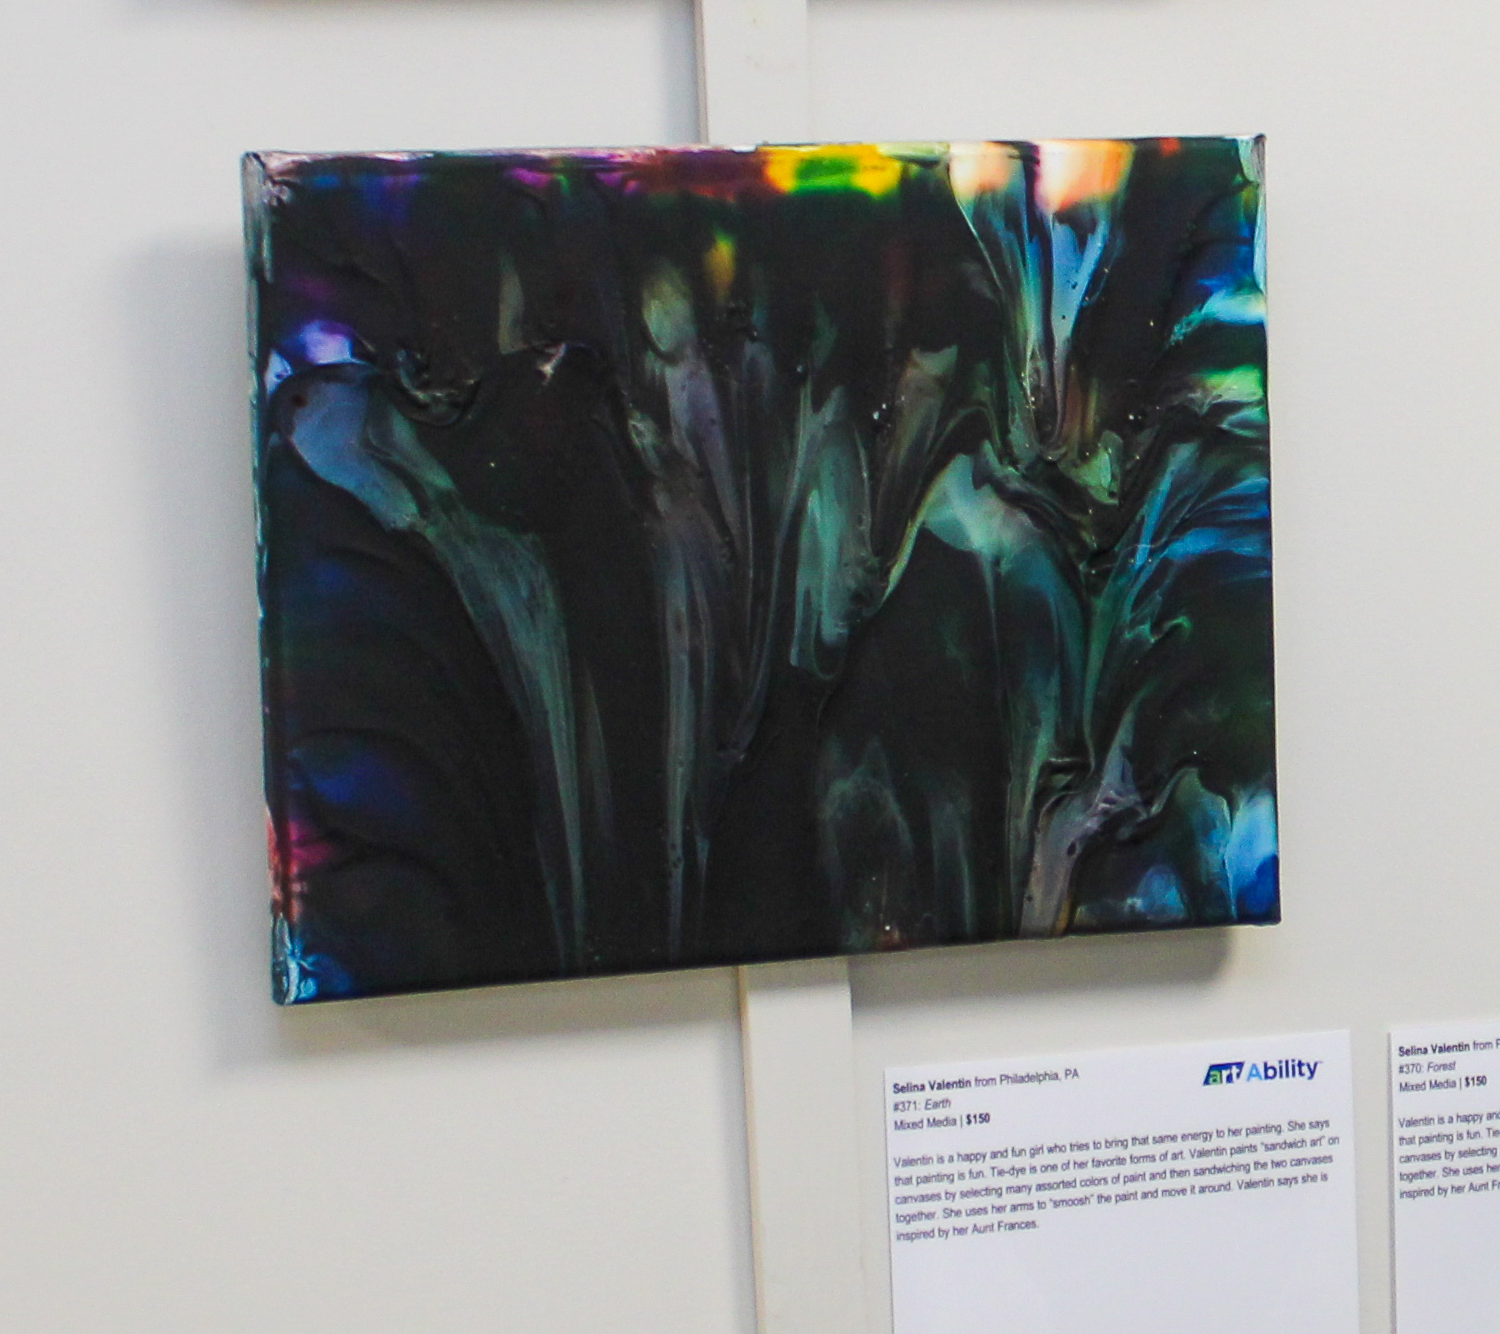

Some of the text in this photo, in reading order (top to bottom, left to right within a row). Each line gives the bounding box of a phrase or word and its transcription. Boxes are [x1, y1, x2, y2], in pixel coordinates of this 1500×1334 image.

[1398, 1045, 1428, 1056] Selina
[1430, 1042, 1470, 1053] Valentin
[1472, 1040, 1493, 1050] from
[1246, 1058, 1319, 1082] Ability
[1426, 1061, 1455, 1071] Forest
[892, 1082, 925, 1093] Selina
[928, 1078, 971, 1090] Valentin
[974, 1076, 996, 1086] from
[1064, 1068, 1079, 1078] PA
[1399, 1075, 1486, 1091] Mixed Media $150
[924, 1098, 951, 1110] Earth
[894, 1112, 990, 1130] Mixed Media $150
[1398, 1116, 1434, 1127] Valentin
[1437, 1115, 1445, 1124] is
[1447, 1115, 1453, 1123] a
[1455, 1113, 1483, 1123] happy
[893, 1155, 933, 1167] Valentin
[936, 1154, 944, 1164] is
[947, 1154, 954, 1163] a
[956, 1152, 986, 1163] happy
[989, 1147, 1008, 1159] and
[1010, 1146, 1026, 1157] fun
[1029, 1144, 1044, 1158] girl
[1046, 1143, 1066, 1153] who
[1069, 1141, 1089, 1152] tries
[1092, 1140, 1101, 1149] to
[1104, 1138, 1128, 1149] bring
[1131, 1135, 1149, 1146] that
[1152, 1134, 1178, 1144] same
[1180, 1131, 1213, 1142] energy
[1215, 1128, 1225, 1138] to
[1227, 1127, 1242, 1136] her
[1287, 1120, 1305, 1131] She
[1308, 1119, 1329, 1130] says
[1398, 1135, 1415, 1145] that
[1418, 1133, 1453, 1145] painting
[1456, 1130, 1463, 1140] is
[894, 1175, 913, 1186] that
[915, 1172, 954, 1185] painting
[957, 1170, 965, 1180] is
[990, 1165, 1026, 1177] Tie-dye
[1028, 1163, 1037, 1174] is
[1039, 1163, 1058, 1173] one
[1060, 1159, 1070, 1171] of
[1072, 1159, 1088, 1169] her
[1091, 1156, 1126, 1167] favorite
[1129, 1154, 1156, 1164] forms
[1158, 1150, 1168, 1161] of
[1189, 1146, 1227, 1158] Valentin
[1229, 1144, 1257, 1157] paints
[1327, 1136, 1339, 1145] on
[1398, 1152, 1441, 1163] canvases
[1444, 1149, 1455, 1161] by
[1457, 1147, 1497, 1158] selecting
[894, 1155, 1332, 1204] canvases by selecting many assorted colors of paint and then sandwiching the two canvases
[942, 1207, 962, 1218] She
[964, 1206, 988, 1216] uses
[991, 1204, 1006, 1213] her
[1009, 1202, 1034, 1212] arms
[1036, 1200, 1046, 1209] to
[1096, 1193, 1112, 1203] the
[1114, 1190, 1137, 1204] paint
[1140, 1188, 1158, 1199] and
[1161, 1187, 1187, 1196] move
[1189, 1184, 1195, 1194] it
[1236, 1177, 1274, 1189] Valentin
[1277, 1176, 1298, 1187] says
[1301, 1173, 1317, 1183] she
[1320, 1171, 1328, 1181] is
[1399, 1186, 1434, 1198] inspired
[1437, 1185, 1448, 1197] by
[1450, 1184, 1465, 1193] her
[1467, 1181, 1489, 1192] Aunt
[896, 1228, 935, 1241] inspired
[937, 1226, 949, 1239] by
[952, 1226, 968, 1235] her
[971, 1222, 994, 1233] Aunt
